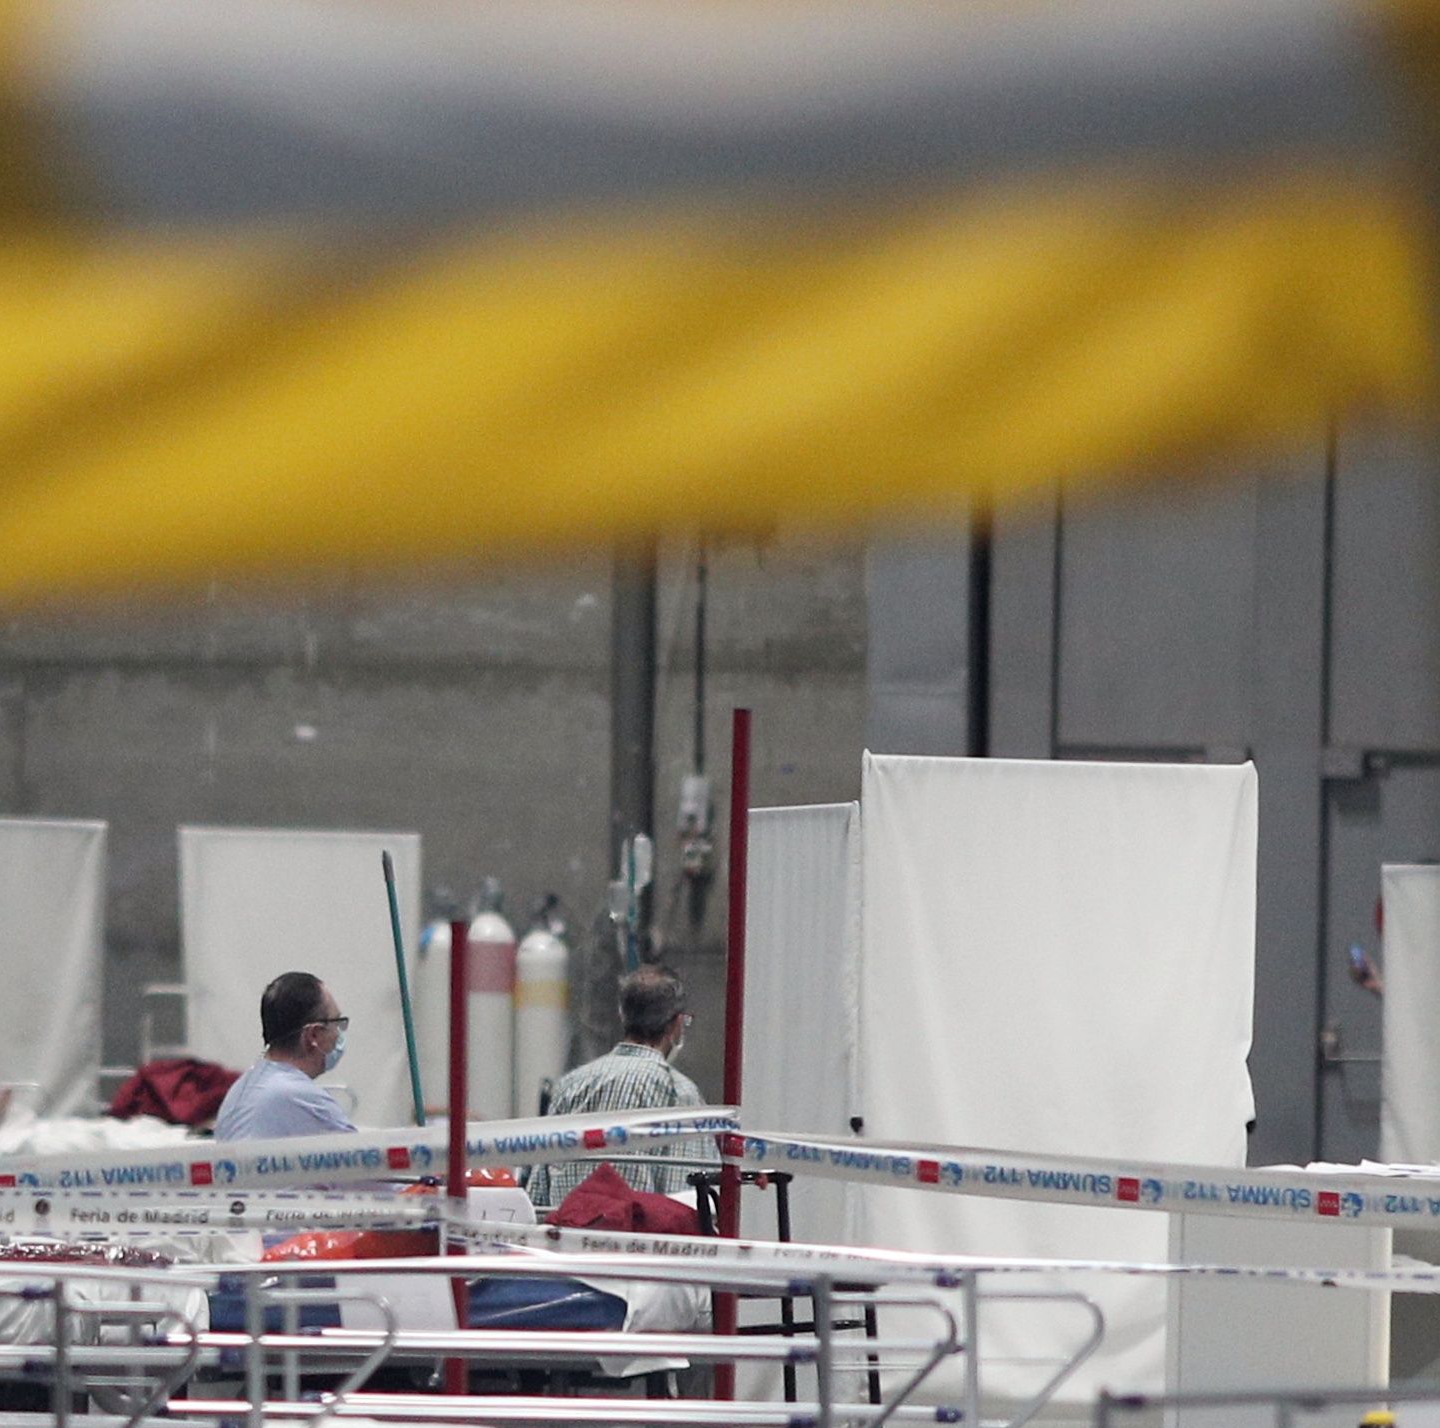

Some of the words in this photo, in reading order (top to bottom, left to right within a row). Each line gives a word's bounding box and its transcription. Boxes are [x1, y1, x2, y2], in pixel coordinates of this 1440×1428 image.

[466, 1139, 483, 1156] 11
[494, 1130, 578, 1152] SUMMA
[298, 1147, 381, 1171] SUMMA
[786, 1143, 821, 1162] 112
[827, 1146, 912, 1177] SUMMA
[102, 1162, 185, 1187] SUMMA
[257, 1154, 292, 1175] 112
[984, 1165, 1019, 1184] 112
[60, 1168, 94, 1189] 112
[1027, 1168, 1112, 1194] SUMMA
[1183, 1181, 1218, 1200] 112
[1226, 1184, 1312, 1212] SUMMA
[1384, 1194, 1420, 1213] 112
[71, 1207, 111, 1224] Feria
[117, 1206, 138, 1224] de
[144, 1207, 210, 1225] Madrid
[626, 1238, 646, 1253] de
[652, 1240, 718, 1257] Madrid
